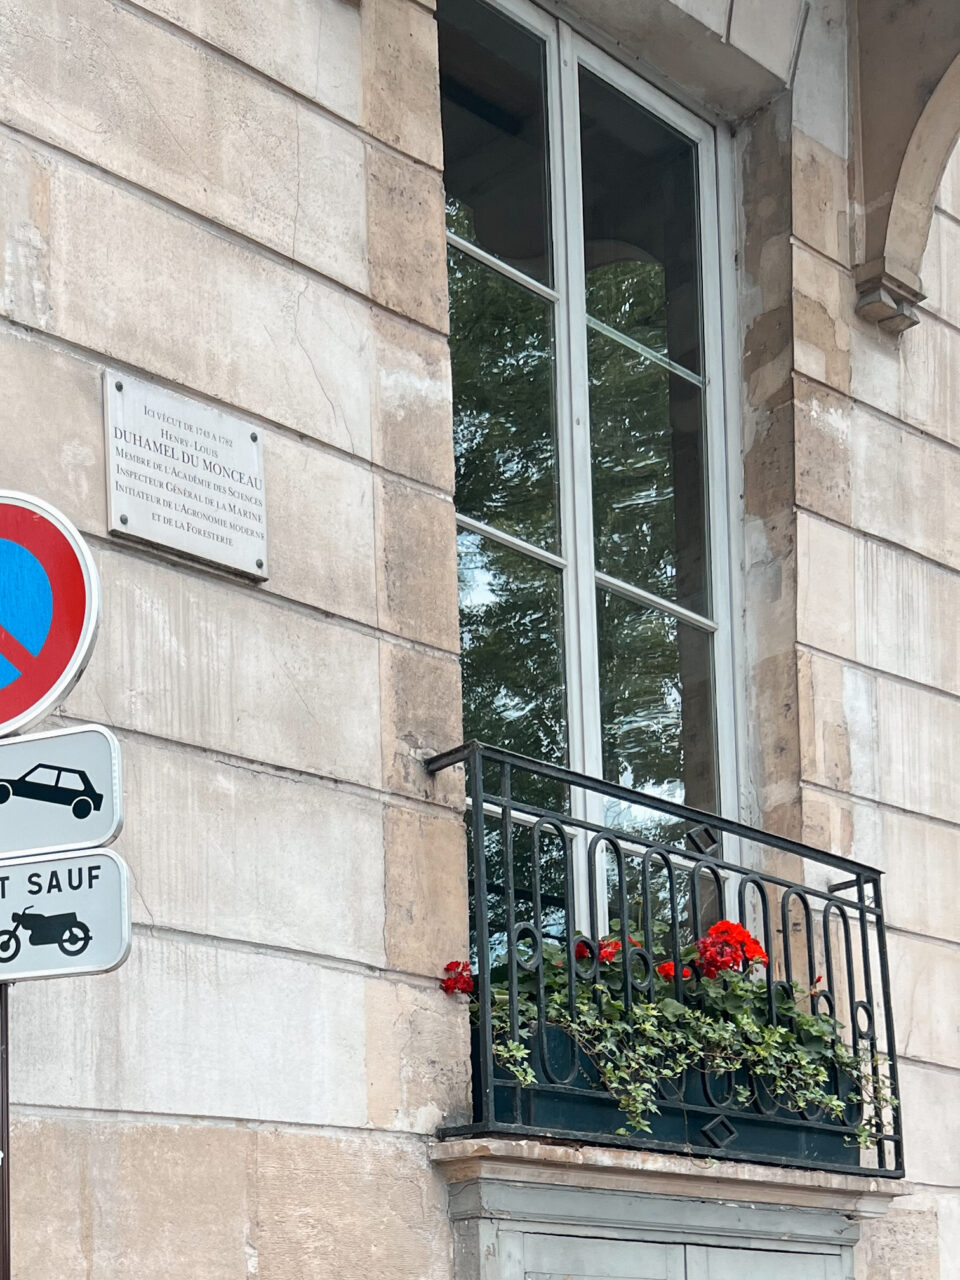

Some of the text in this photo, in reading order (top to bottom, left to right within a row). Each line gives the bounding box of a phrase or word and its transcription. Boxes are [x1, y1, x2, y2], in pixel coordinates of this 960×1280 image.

[183, 422, 193, 433] DE
[114, 426, 262, 491] DUHAMEL DU MONCEAU
[115, 446, 151, 468] MEMBRE
[152, 461, 163, 472] DE
[213, 483, 227, 495] DES
[228, 486, 263, 508] SCIENCES
[115, 480, 161, 506] INITIATEUR
[162, 498, 173, 510] DE
[229, 522, 265, 541] MODERNE
[116, 464, 164, 489] INSPECTEUR
[204, 496, 215, 507] DE
[216, 501, 227, 512] LA
[228, 503, 263, 524] MARINE
[151, 512, 234, 547] ET DE LA FORESTERIE
[27, 865, 102, 896] SAUF
